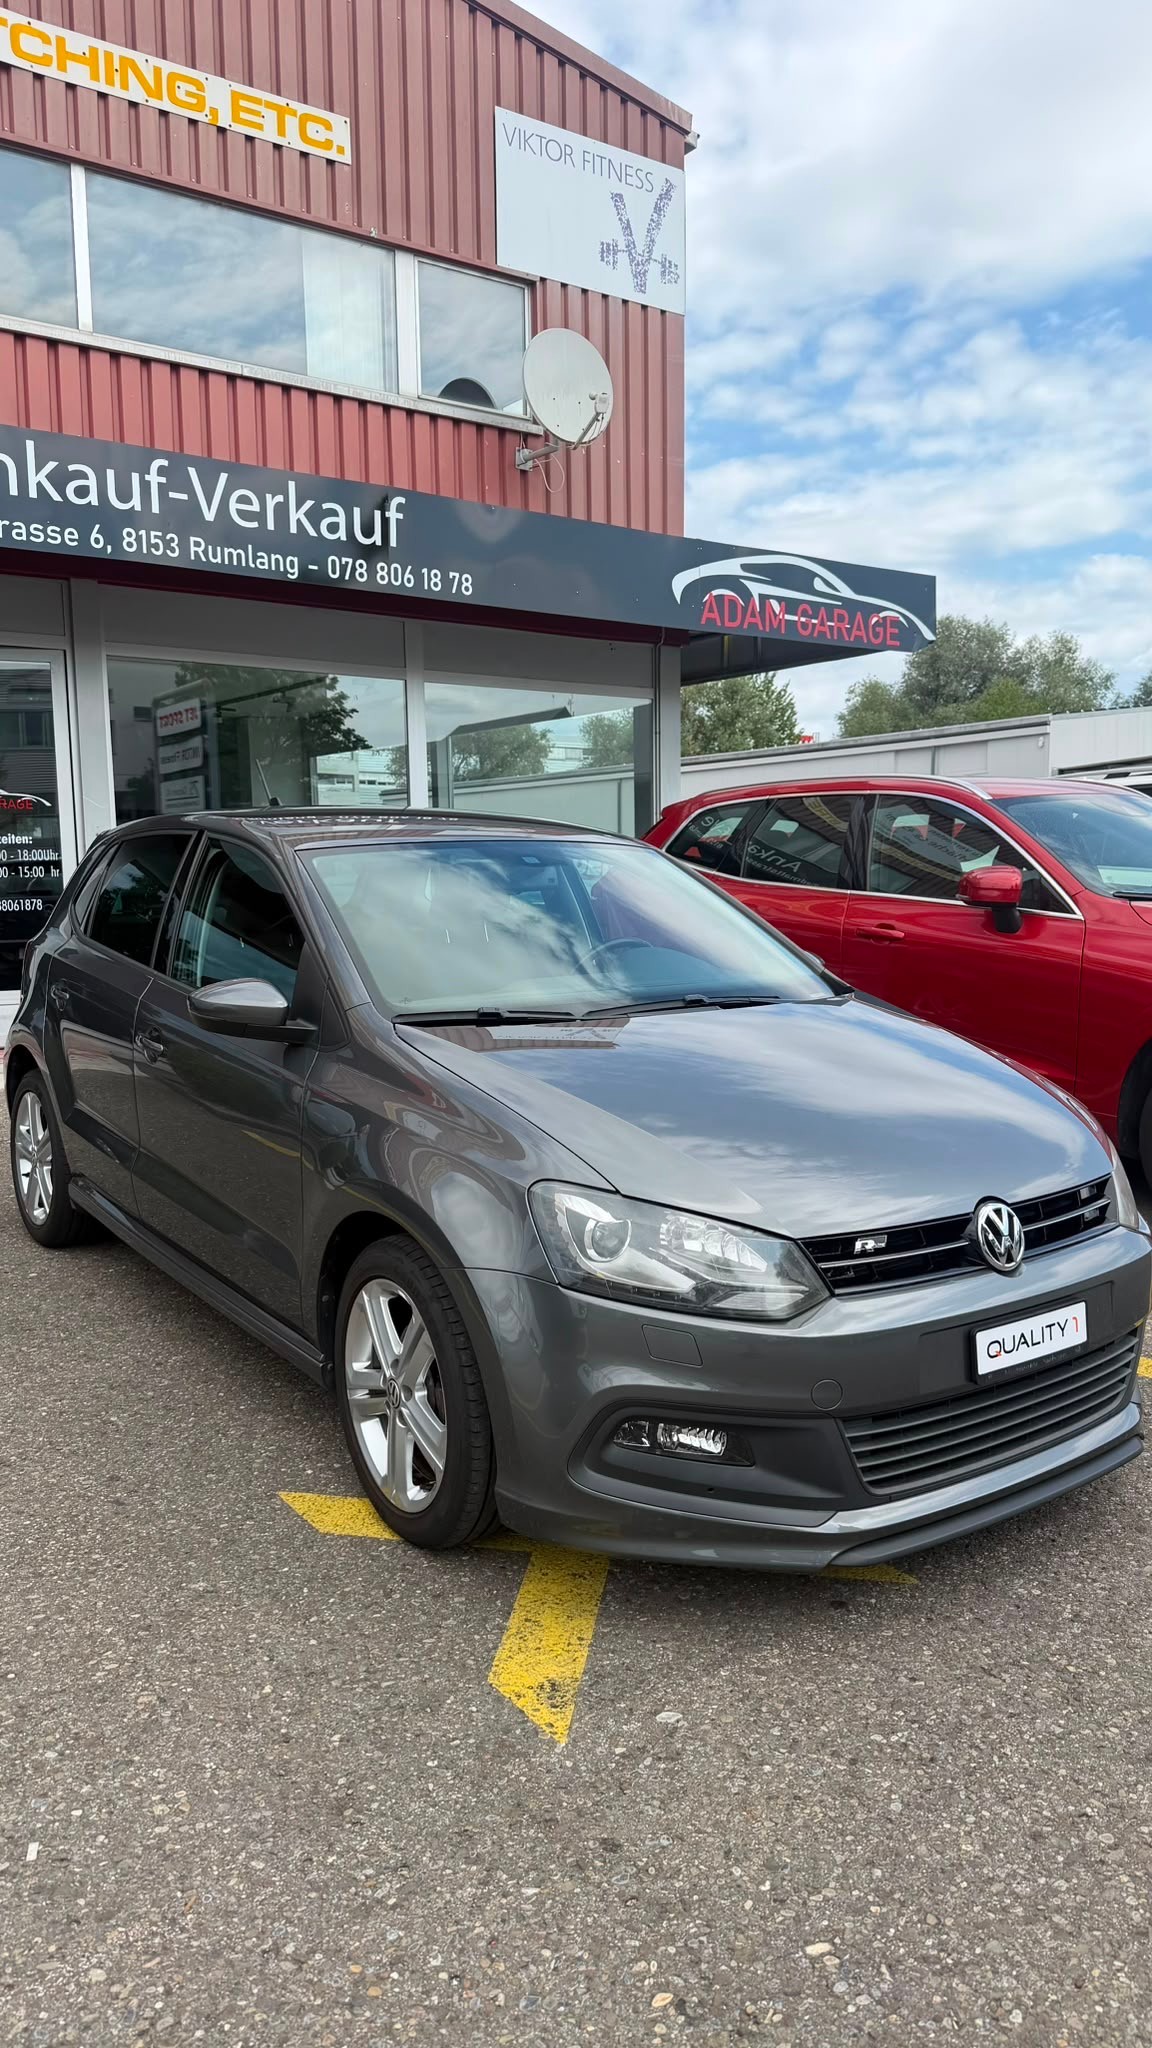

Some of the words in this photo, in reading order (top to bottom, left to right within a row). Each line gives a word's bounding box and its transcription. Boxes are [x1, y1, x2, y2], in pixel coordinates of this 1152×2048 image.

[231, 90, 345, 156] ETC.
[503, 123, 575, 168] VIKTOR
[582, 150, 654, 193] FITNESS
[90, 523, 112, 555] 6,
[122, 528, 179, 558] 8153
[189, 536, 299, 580] Rumlang
[327, 555, 368, 582] 078
[376, 562, 414, 588] 806
[421, 567, 442, 591] 18
[449, 572, 473, 596] 78
[701, 592, 785, 634] ADAM
[797, 603, 901, 647] GARAGE
[0, 833, 33, 844] eiten:
[18, 865, 45, 878] 15:00
[0, 898, 43, 911] 8061878
[986, 1318, 1069, 1359] QUALITY
[1072, 1316, 1079, 1333] 1
